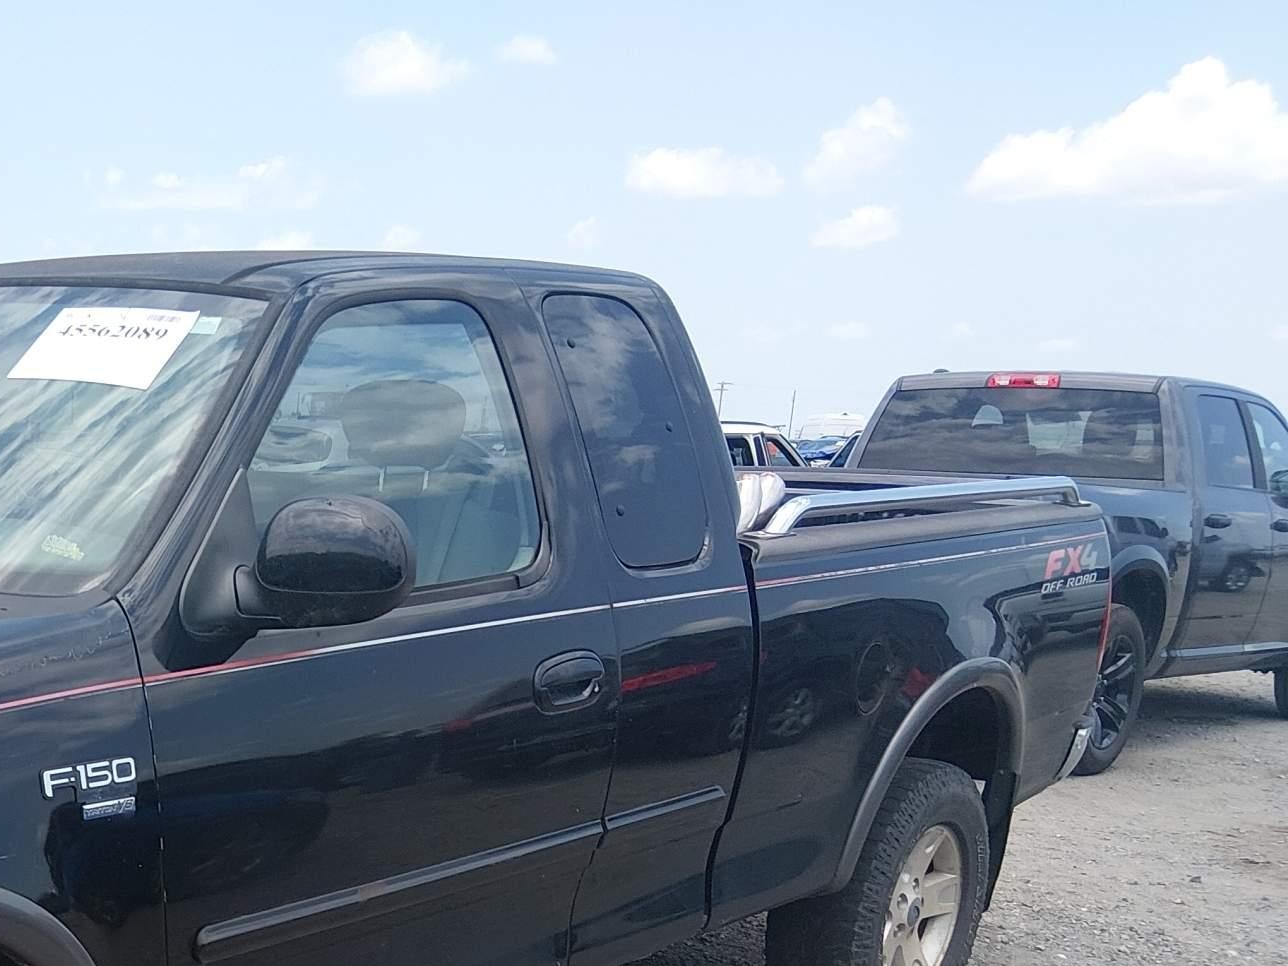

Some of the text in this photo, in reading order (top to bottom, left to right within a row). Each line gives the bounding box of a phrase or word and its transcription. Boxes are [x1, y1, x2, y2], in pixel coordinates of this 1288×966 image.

[58, 324, 169, 340] 45562089
[1044, 543, 1098, 580] FX4
[1041, 573, 1097, 594] OFF ROAD
